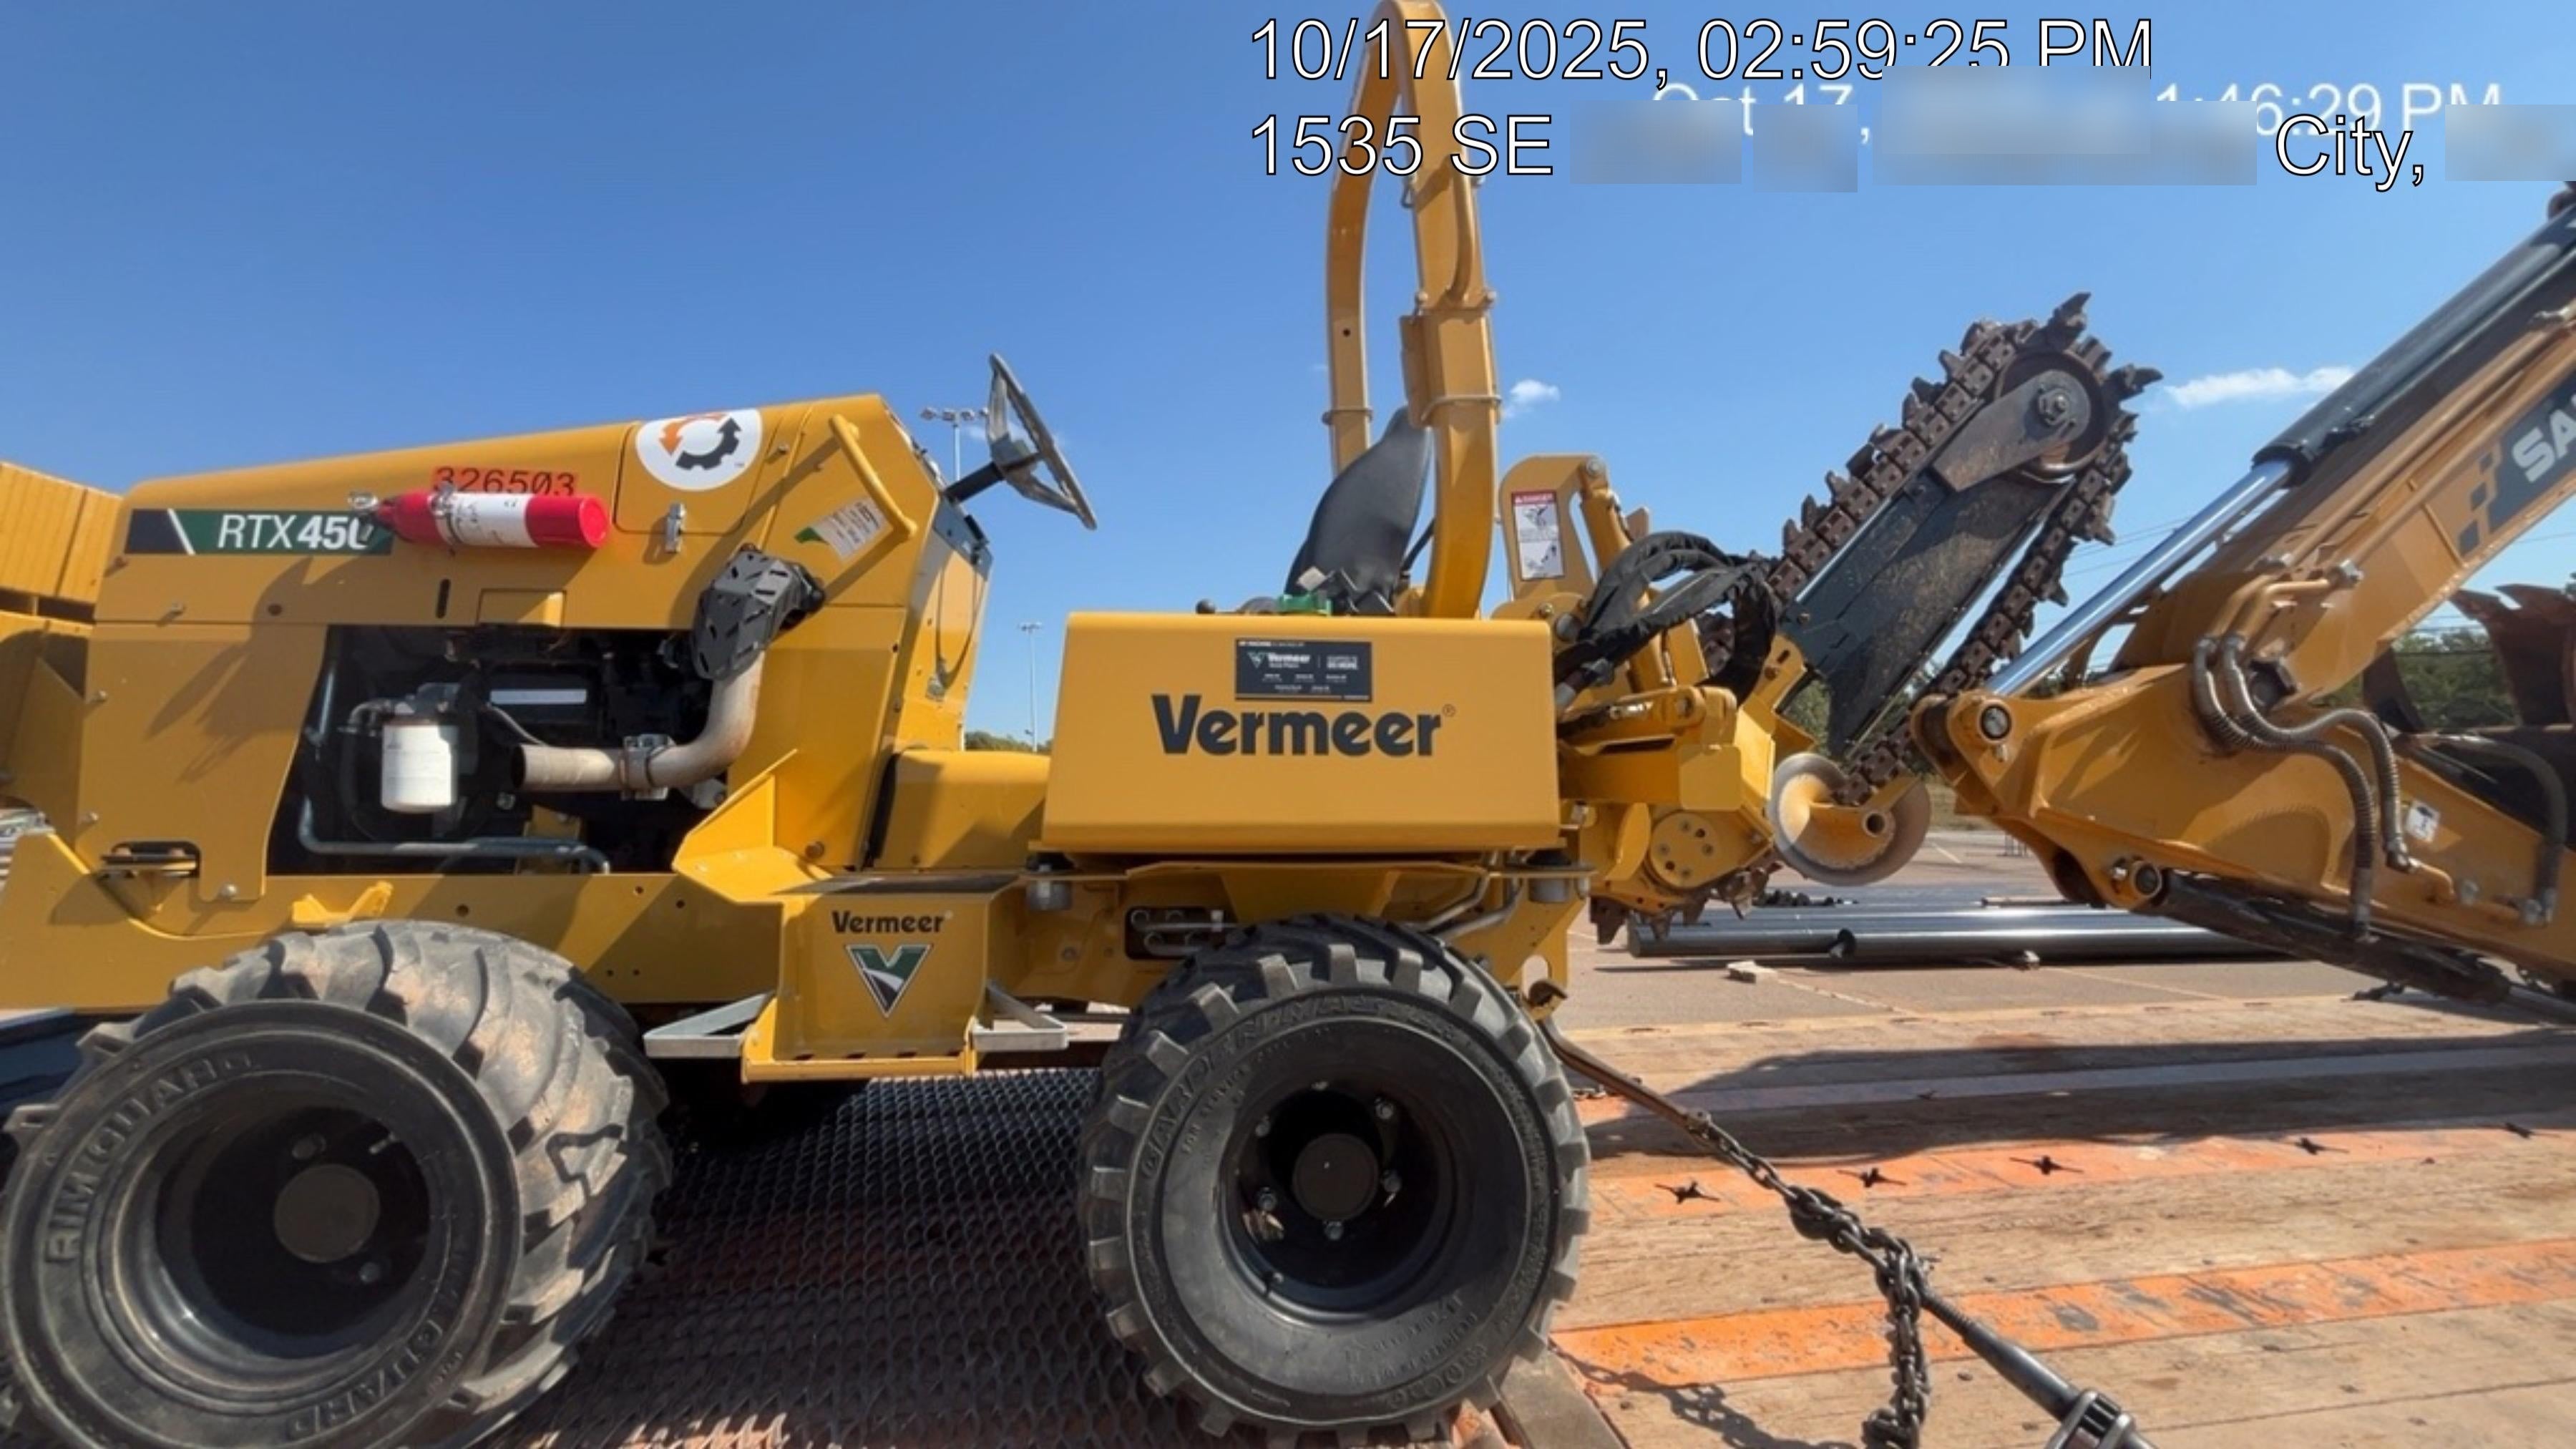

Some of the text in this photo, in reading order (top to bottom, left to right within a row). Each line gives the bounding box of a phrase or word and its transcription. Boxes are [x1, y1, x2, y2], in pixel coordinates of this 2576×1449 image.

[2512, 394, 2576, 484] SA
[218, 514, 297, 549] RTX
[1151, 694, 1441, 757] Vermeer
[831, 910, 945, 934] Vermeer
